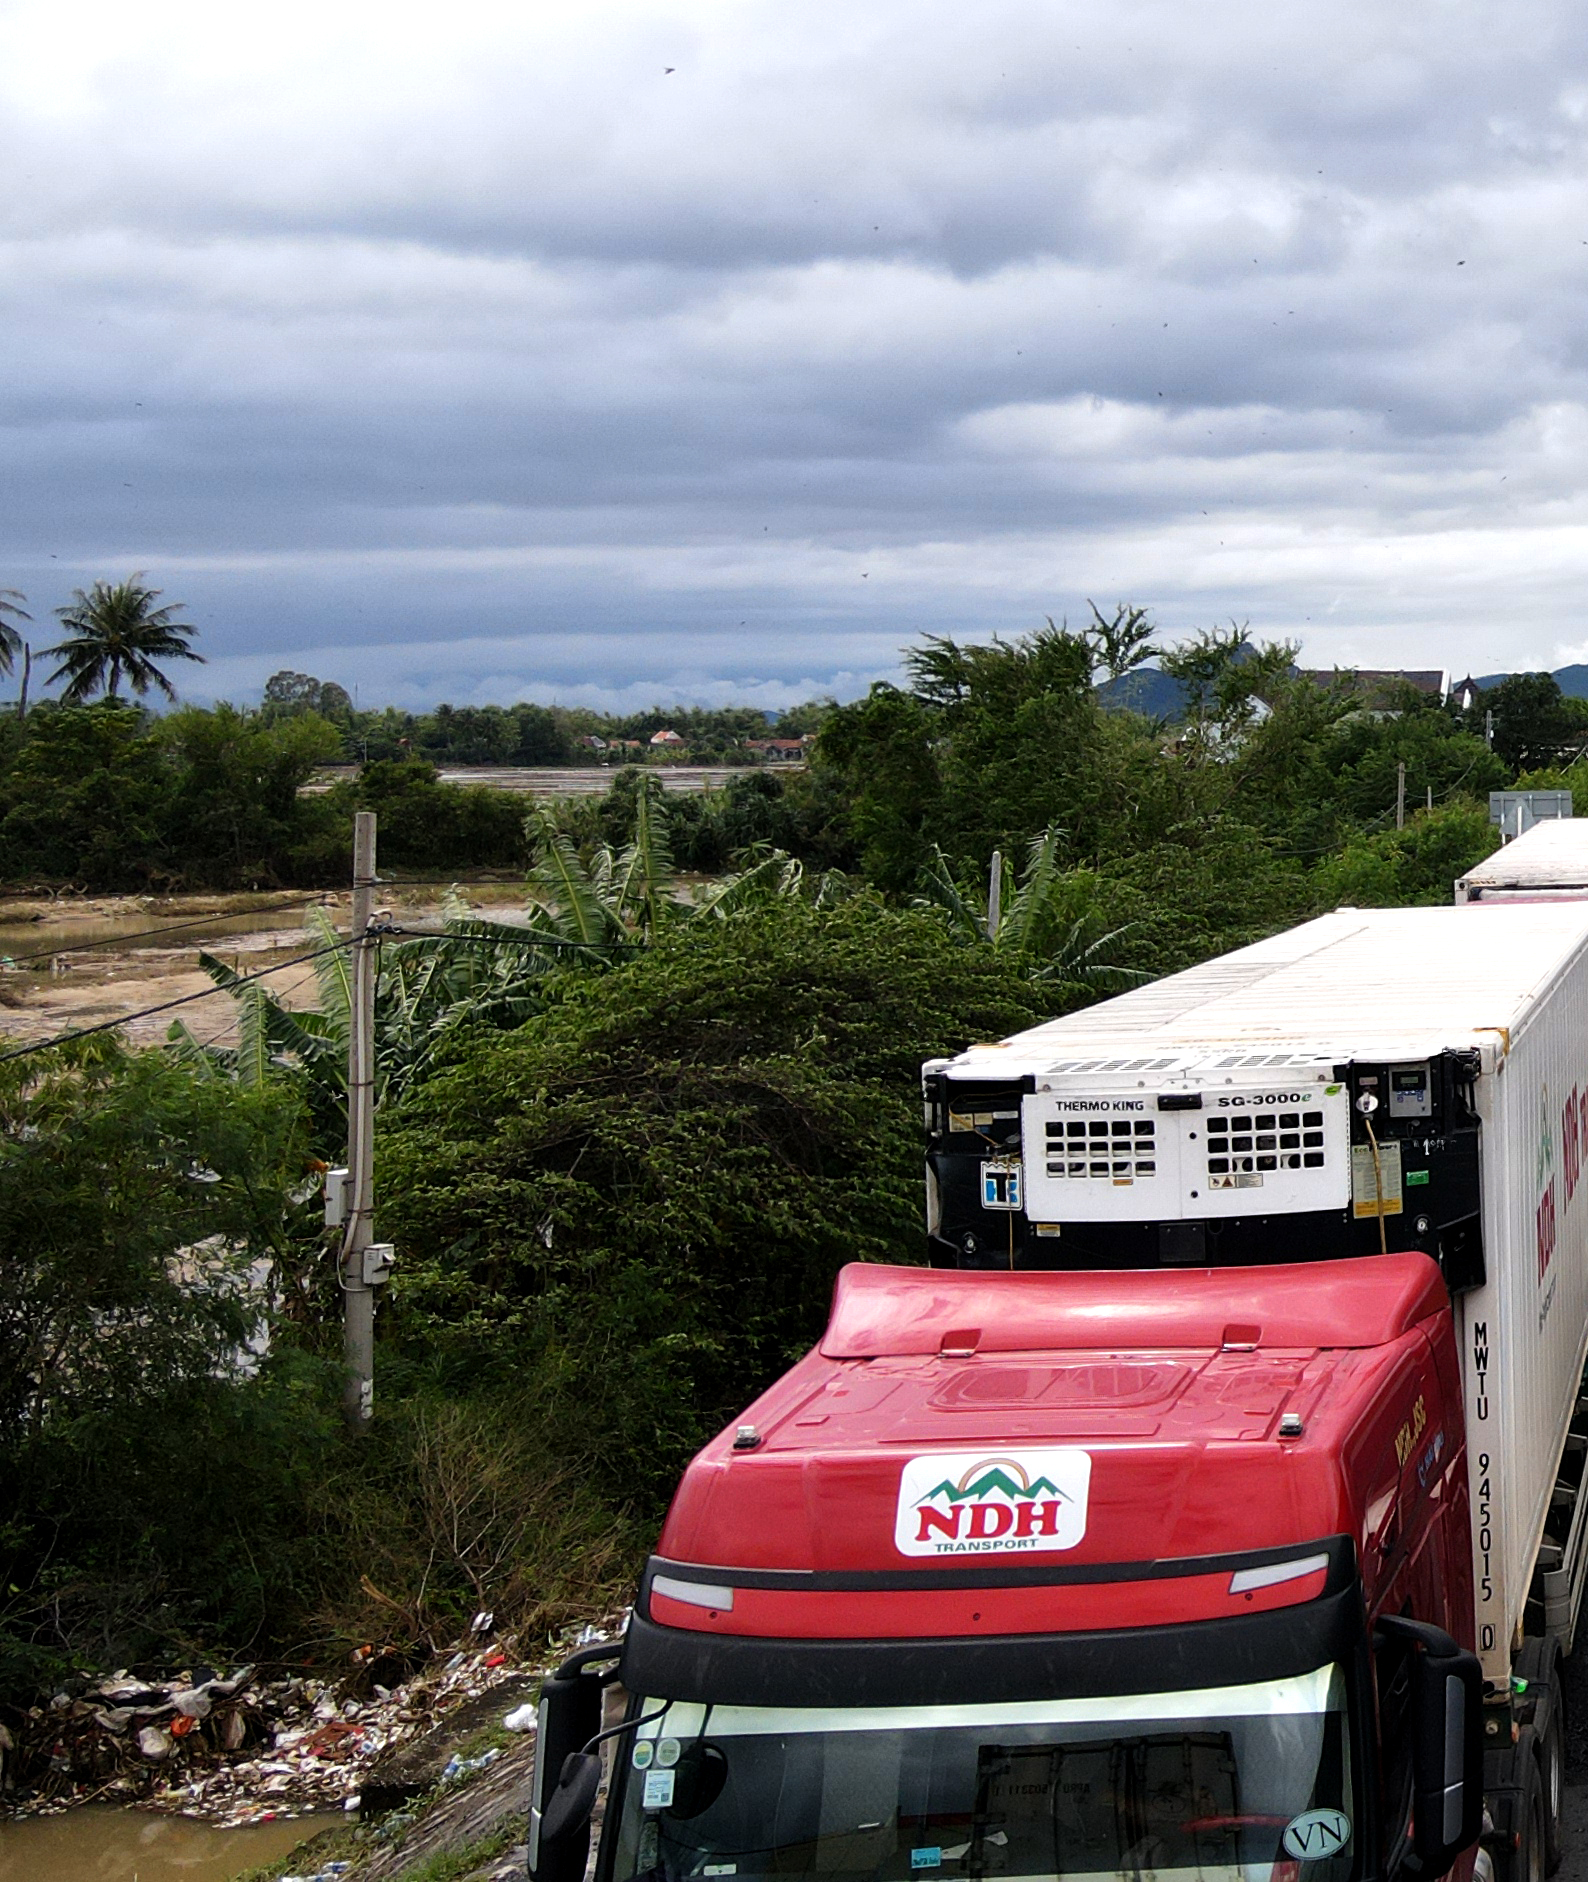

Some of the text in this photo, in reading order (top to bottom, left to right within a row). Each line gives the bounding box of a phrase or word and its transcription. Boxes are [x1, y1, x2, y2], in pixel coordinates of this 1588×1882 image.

[1055, 1100, 1144, 1111] THERMO KING
[1217, 1093, 1312, 1108] SG-3000e
[1474, 1322, 1489, 1420] MWTU
[914, 1500, 1062, 1542] NDH
[1478, 1453, 1492, 1602] 945015
[934, 1538, 1039, 1553] TRANSPORT
[1290, 1817, 1343, 1852] VN
